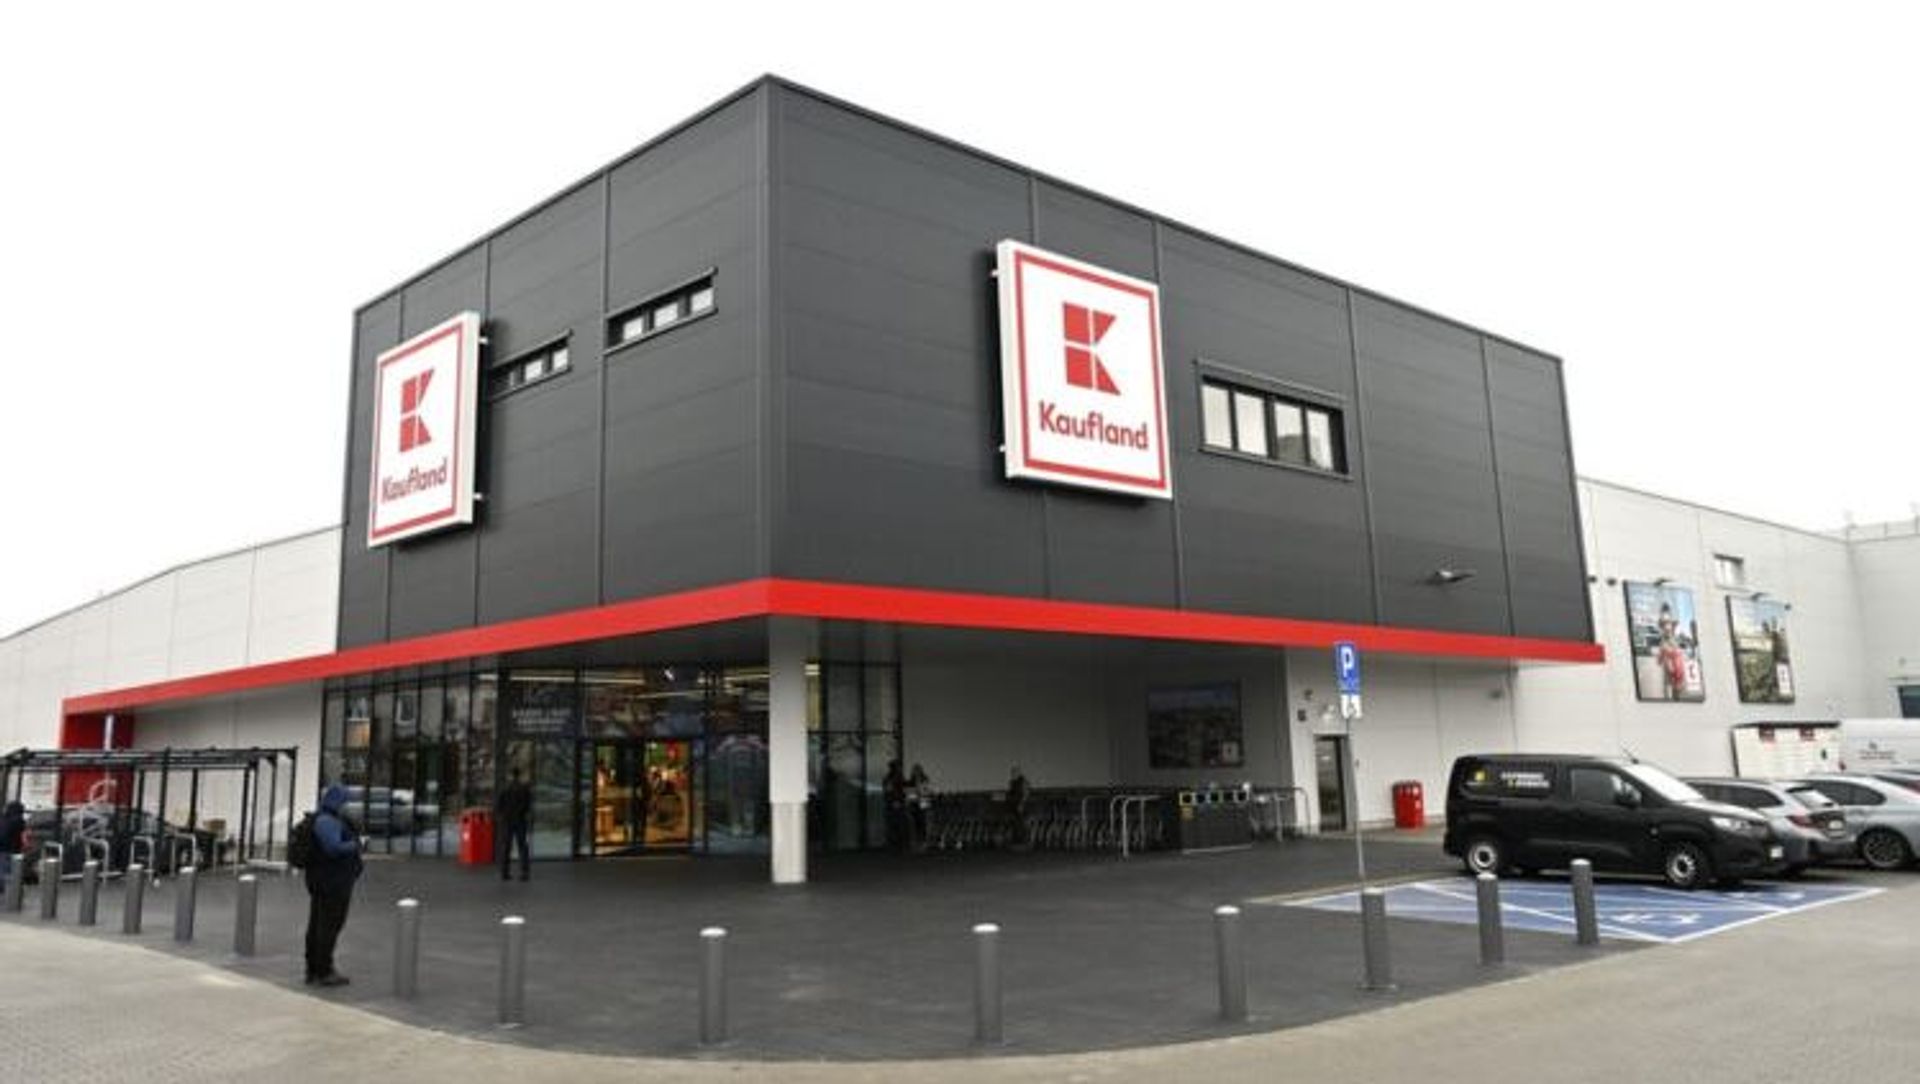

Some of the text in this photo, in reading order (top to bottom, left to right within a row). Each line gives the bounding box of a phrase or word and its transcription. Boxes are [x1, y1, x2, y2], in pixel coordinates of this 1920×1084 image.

[1063, 302, 1121, 396] K
[399, 368, 434, 453] K
[1039, 400, 1149, 450] Kaufland
[380, 457, 448, 502] Kaufland
[1340, 645, 1355, 678] P
